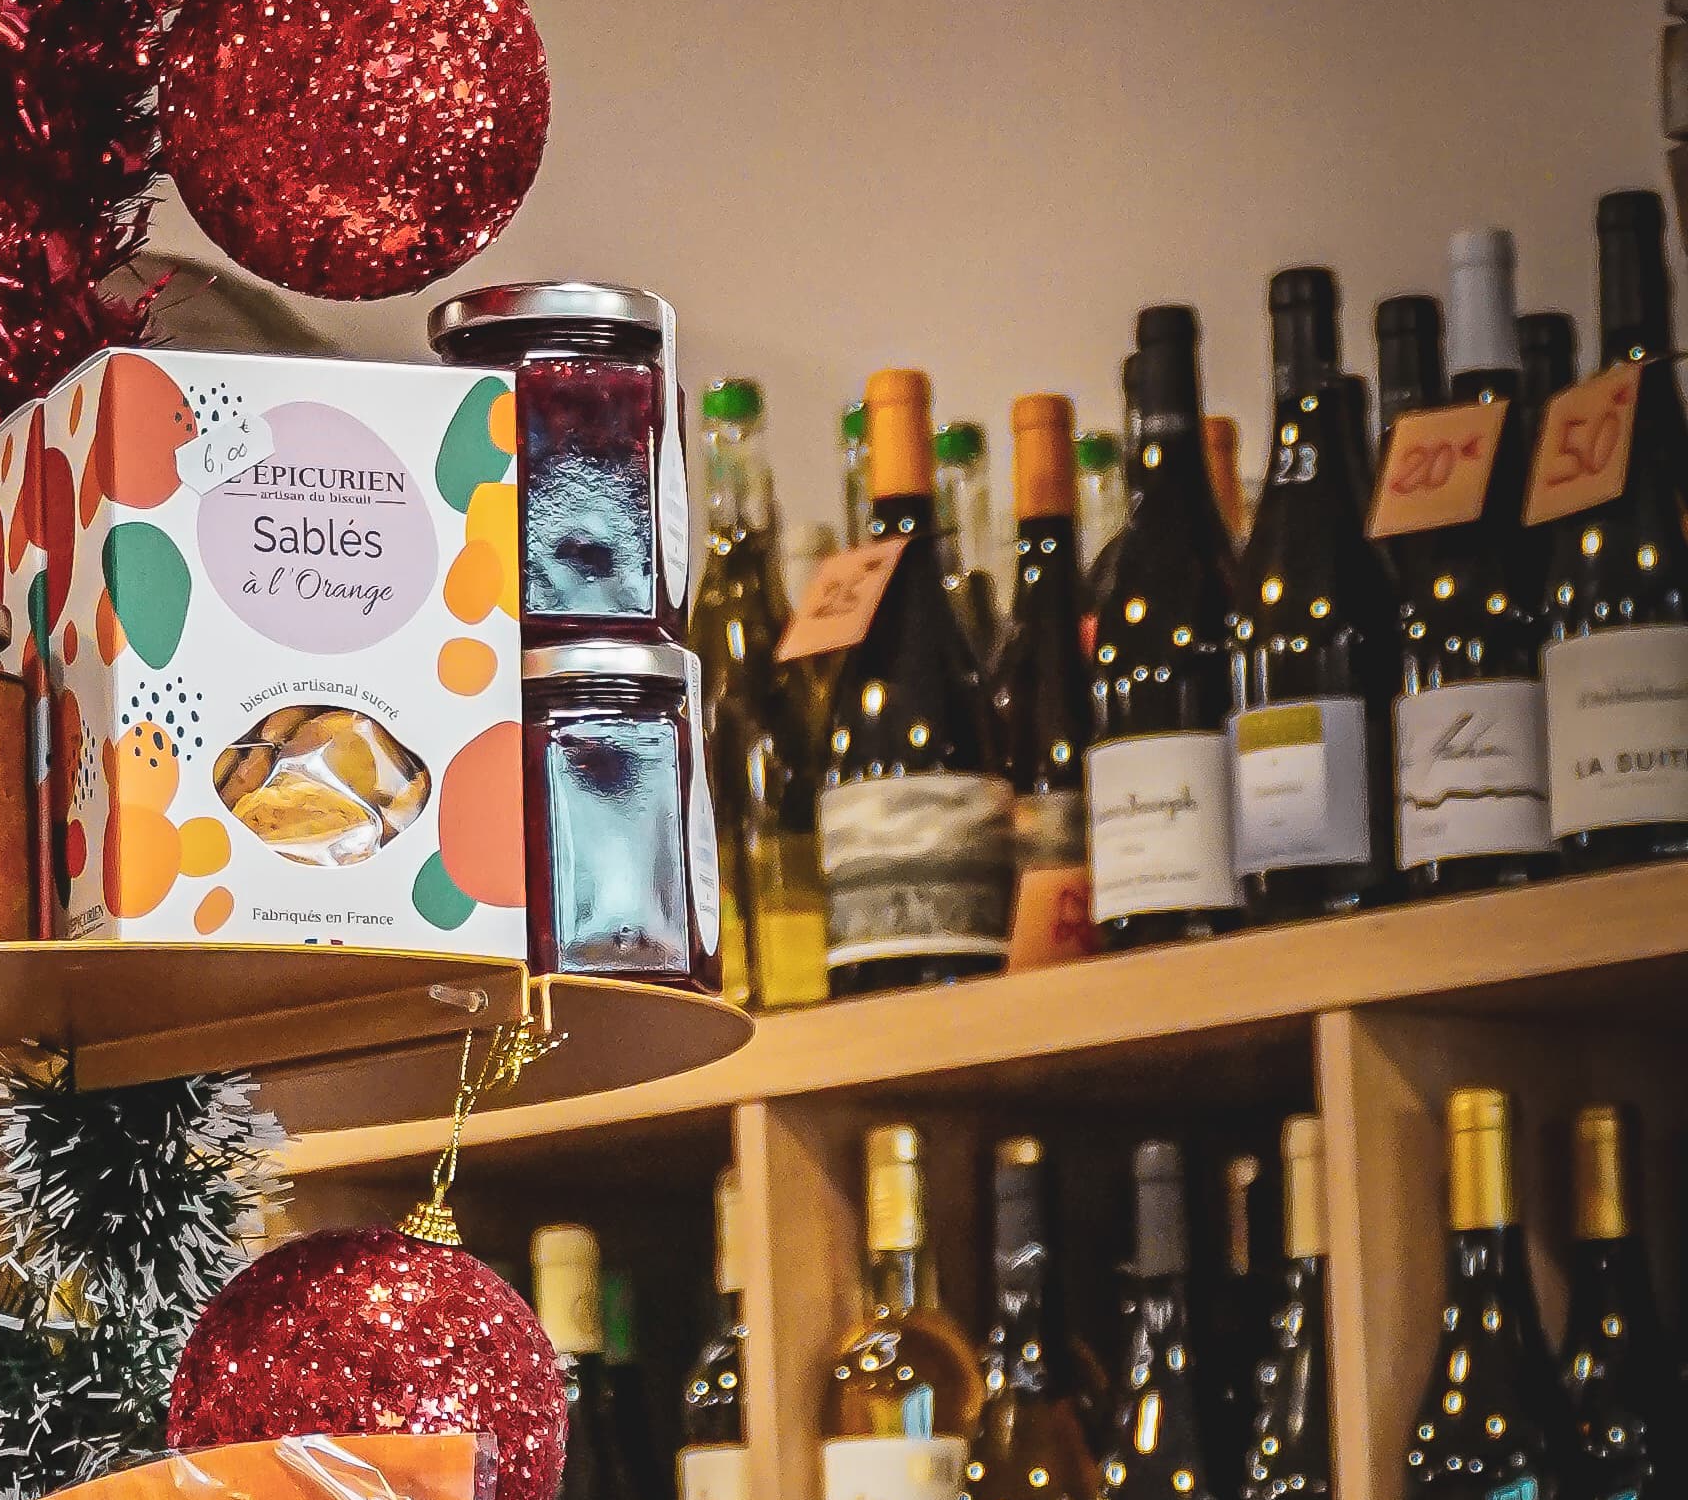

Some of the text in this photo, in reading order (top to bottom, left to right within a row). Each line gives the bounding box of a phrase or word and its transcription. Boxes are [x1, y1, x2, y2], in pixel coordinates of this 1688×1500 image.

[225, 461, 407, 493] ÉPICURIEN
[260, 490, 372, 505] artisan du biscuit
[253, 515, 384, 559] Sablés
[242, 570, 263, 595] à
[240, 678, 401, 722] biscuit artisanal sucré
[252, 907, 395, 927] Fabriqués en France
